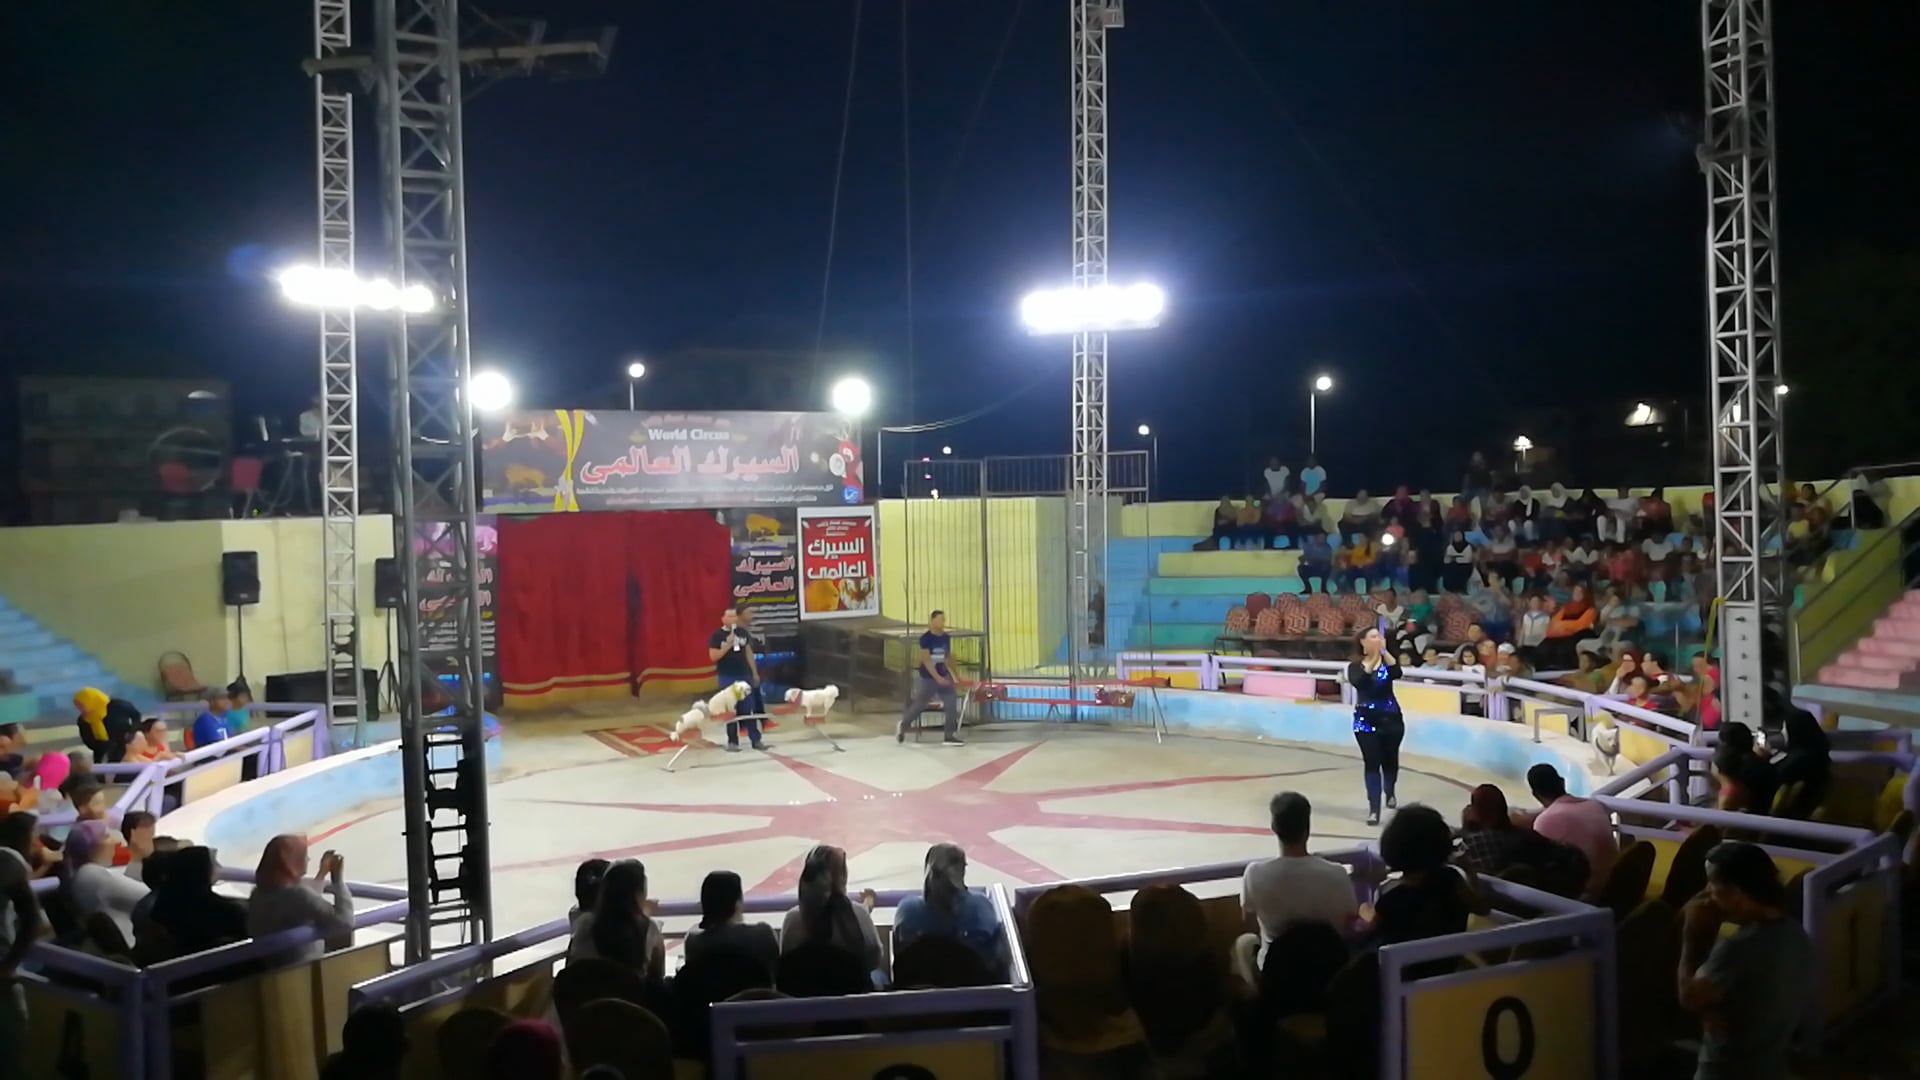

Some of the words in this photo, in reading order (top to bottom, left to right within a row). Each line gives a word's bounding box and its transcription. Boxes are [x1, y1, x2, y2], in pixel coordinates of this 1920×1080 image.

[648, 428, 687, 441] World
[698, 445, 800, 482] السيرك
[807, 537, 864, 559] السيرك
[735, 556, 796, 575] السيرك
